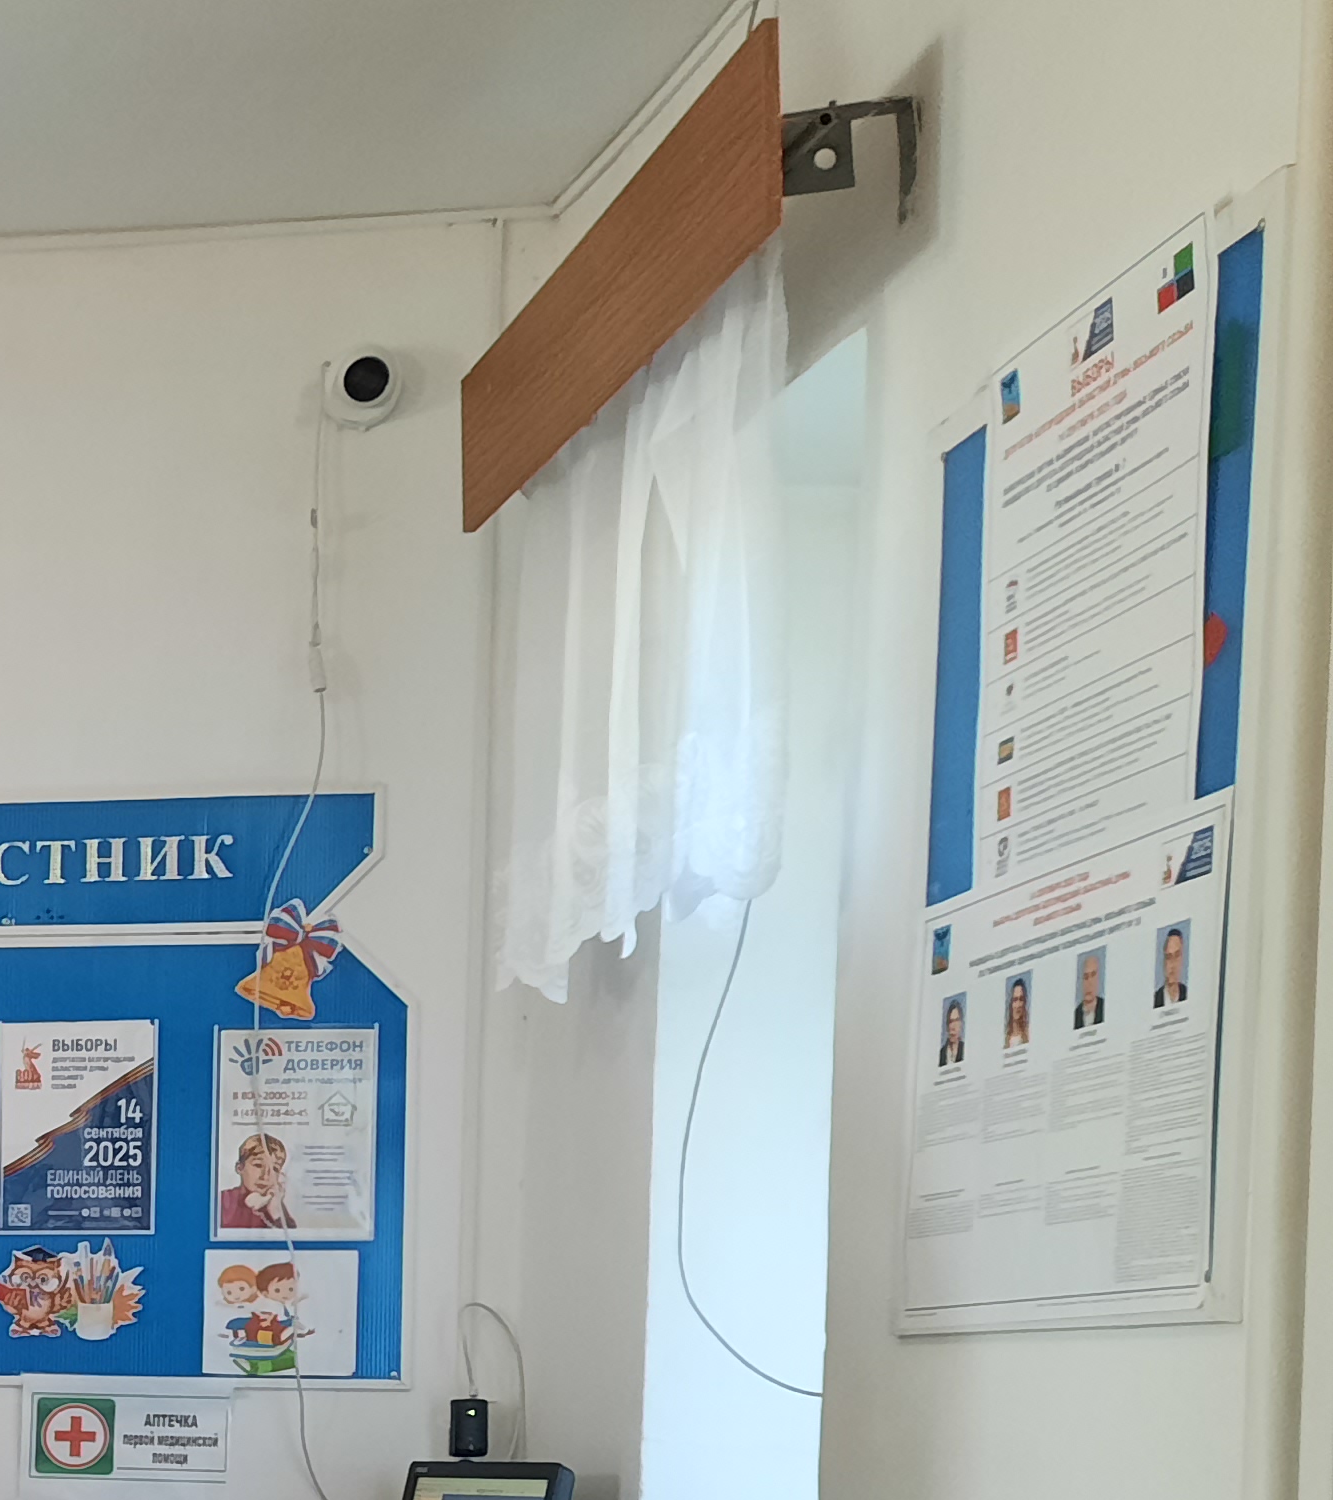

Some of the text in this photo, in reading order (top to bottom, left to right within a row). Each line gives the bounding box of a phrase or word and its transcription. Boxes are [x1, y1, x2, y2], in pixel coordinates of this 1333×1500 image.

[51, 1038, 118, 1053] ВЫБОРЫ
[284, 1040, 364, 1053] ТЕЛЕФОН
[283, 1058, 364, 1074] ДОВЕРИЯ
[241, 1091, 308, 1100] 80-2000-122
[117, 1097, 144, 1124] 14
[84, 1125, 143, 1141] сентября
[83, 1141, 143, 1167] 2025
[46, 1167, 142, 1185] ЕДИНЫЙ ДЕНЬ
[144, 1413, 198, 1428] АПТЕЧКА
[123, 1431, 218, 1449] первой медицинской
[152, 1452, 188, 1467] помощи
